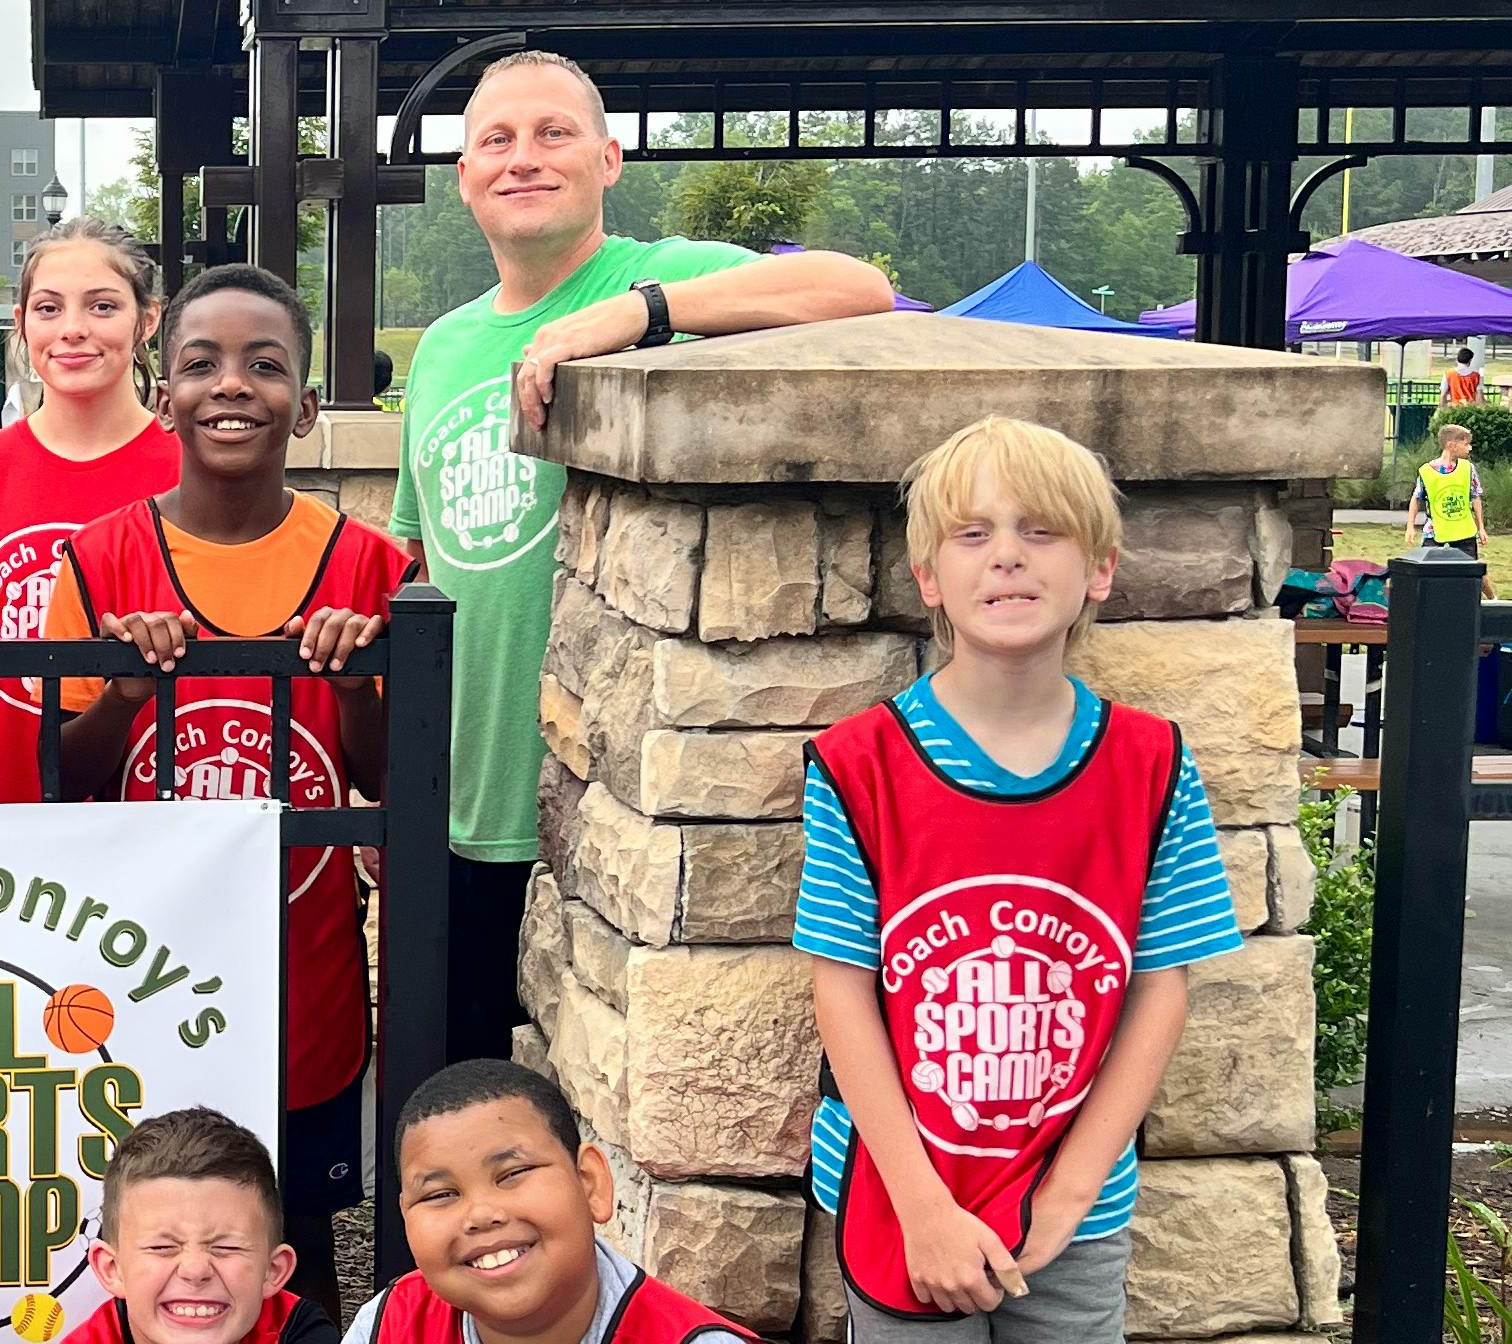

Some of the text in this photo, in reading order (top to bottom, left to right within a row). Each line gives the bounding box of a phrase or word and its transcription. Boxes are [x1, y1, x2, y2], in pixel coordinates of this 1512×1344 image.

[455, 484, 521, 532] CAMP
[134, 719, 324, 801] Cch Conoy's
[190, 763, 265, 800] ALL
[882, 900, 1122, 995] Coach Conroy's
[956, 959, 1050, 1003] ALL
[914, 999, 1086, 1053] SPORTS
[945, 1048, 1053, 1102] CAMP
